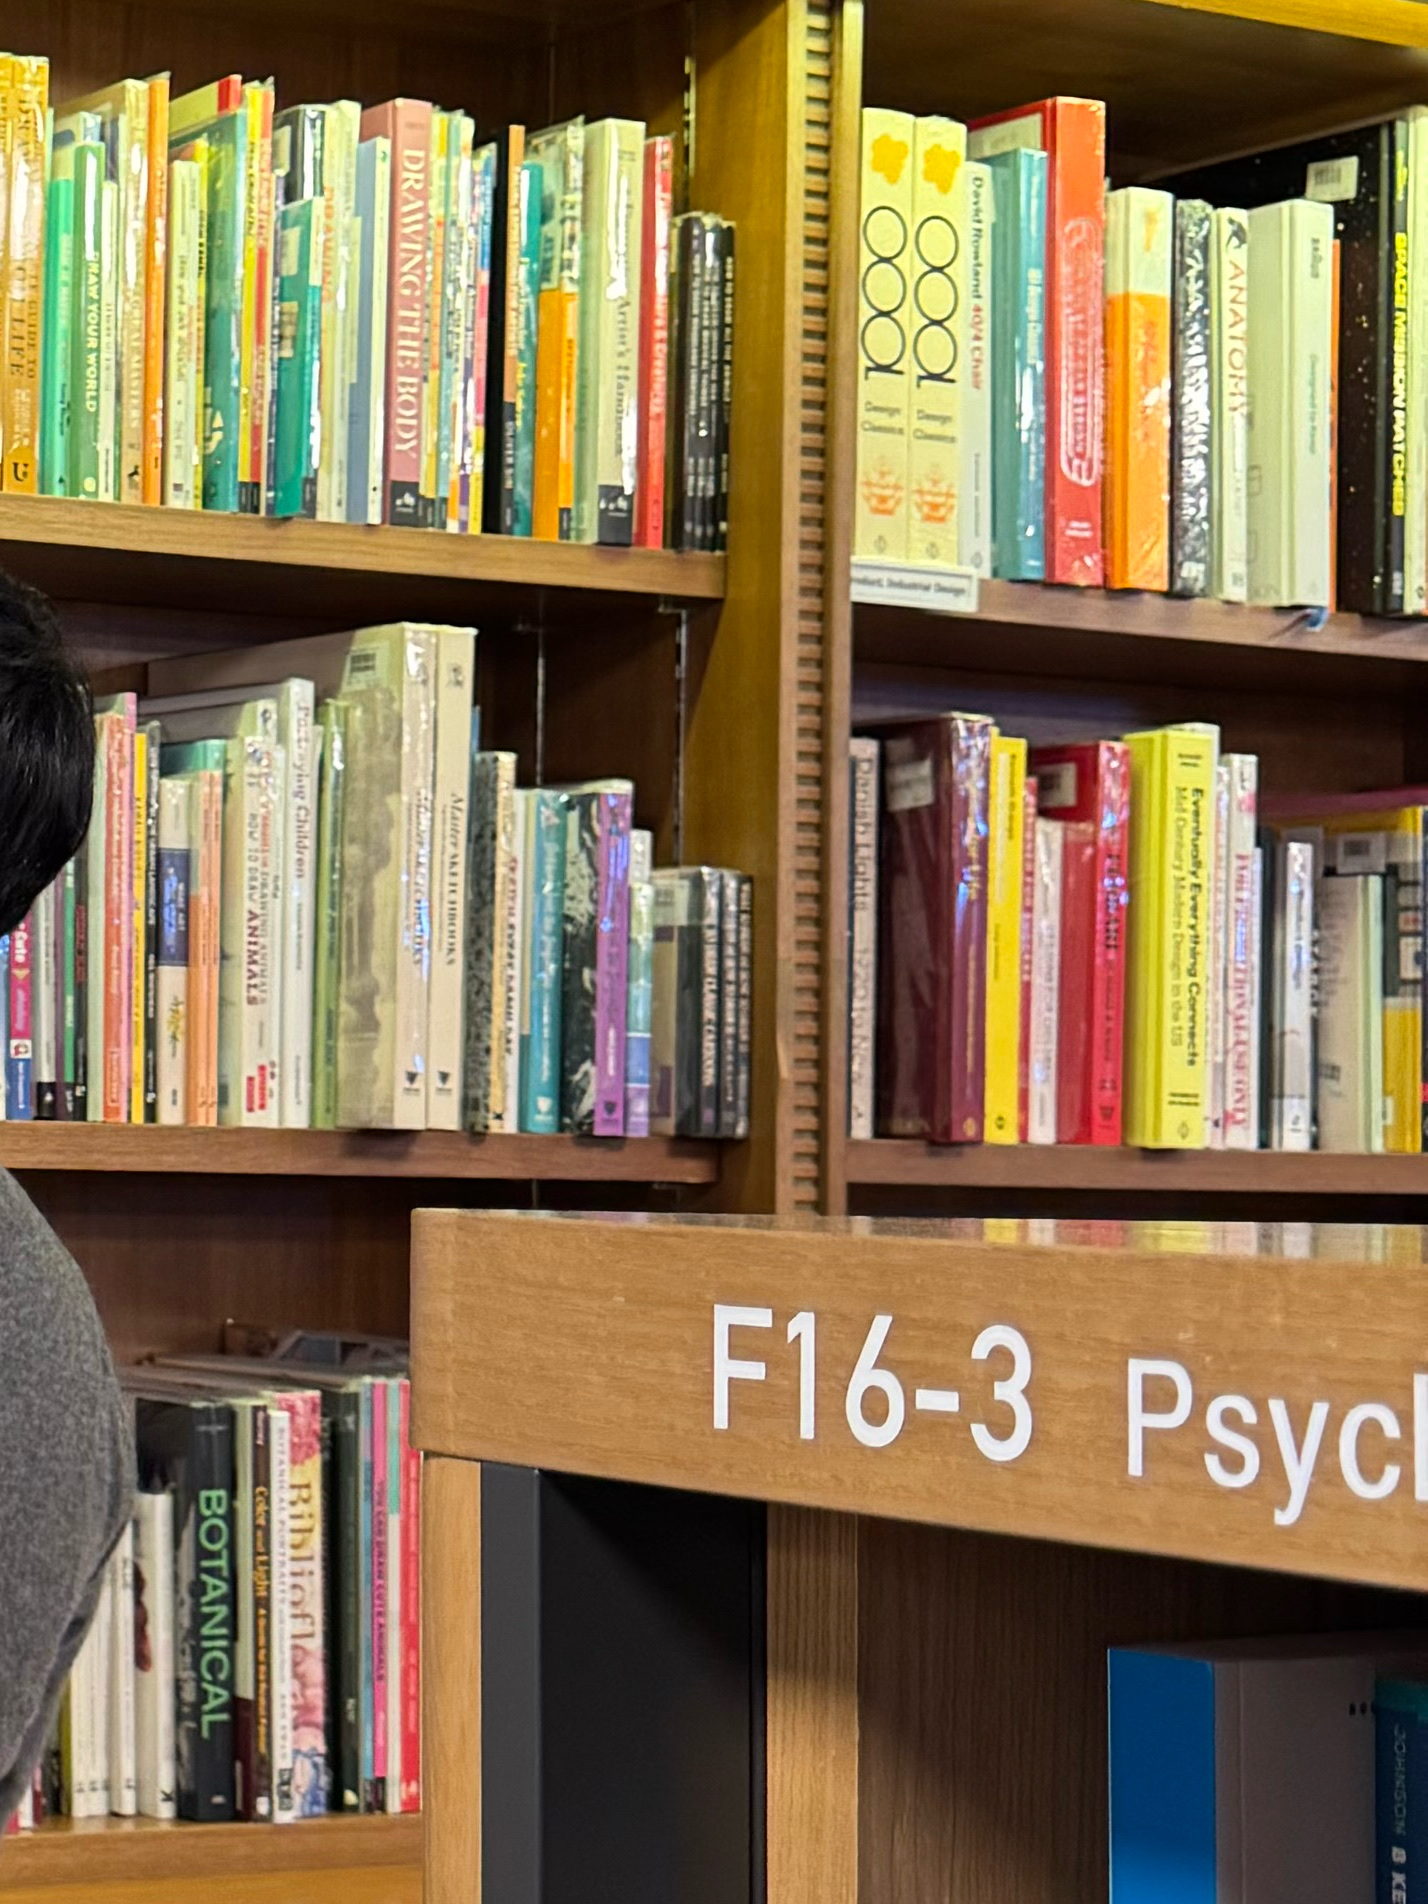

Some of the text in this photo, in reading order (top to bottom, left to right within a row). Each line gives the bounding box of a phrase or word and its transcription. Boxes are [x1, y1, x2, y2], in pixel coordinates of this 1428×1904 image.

[393, 149, 425, 458] DRAWING THE BODY
[1185, 787, 1205, 1068] Eventually Everything Connects
[713, 1304, 1033, 1462] F16-3
[198, 1488, 231, 1740] BOTANICAL
